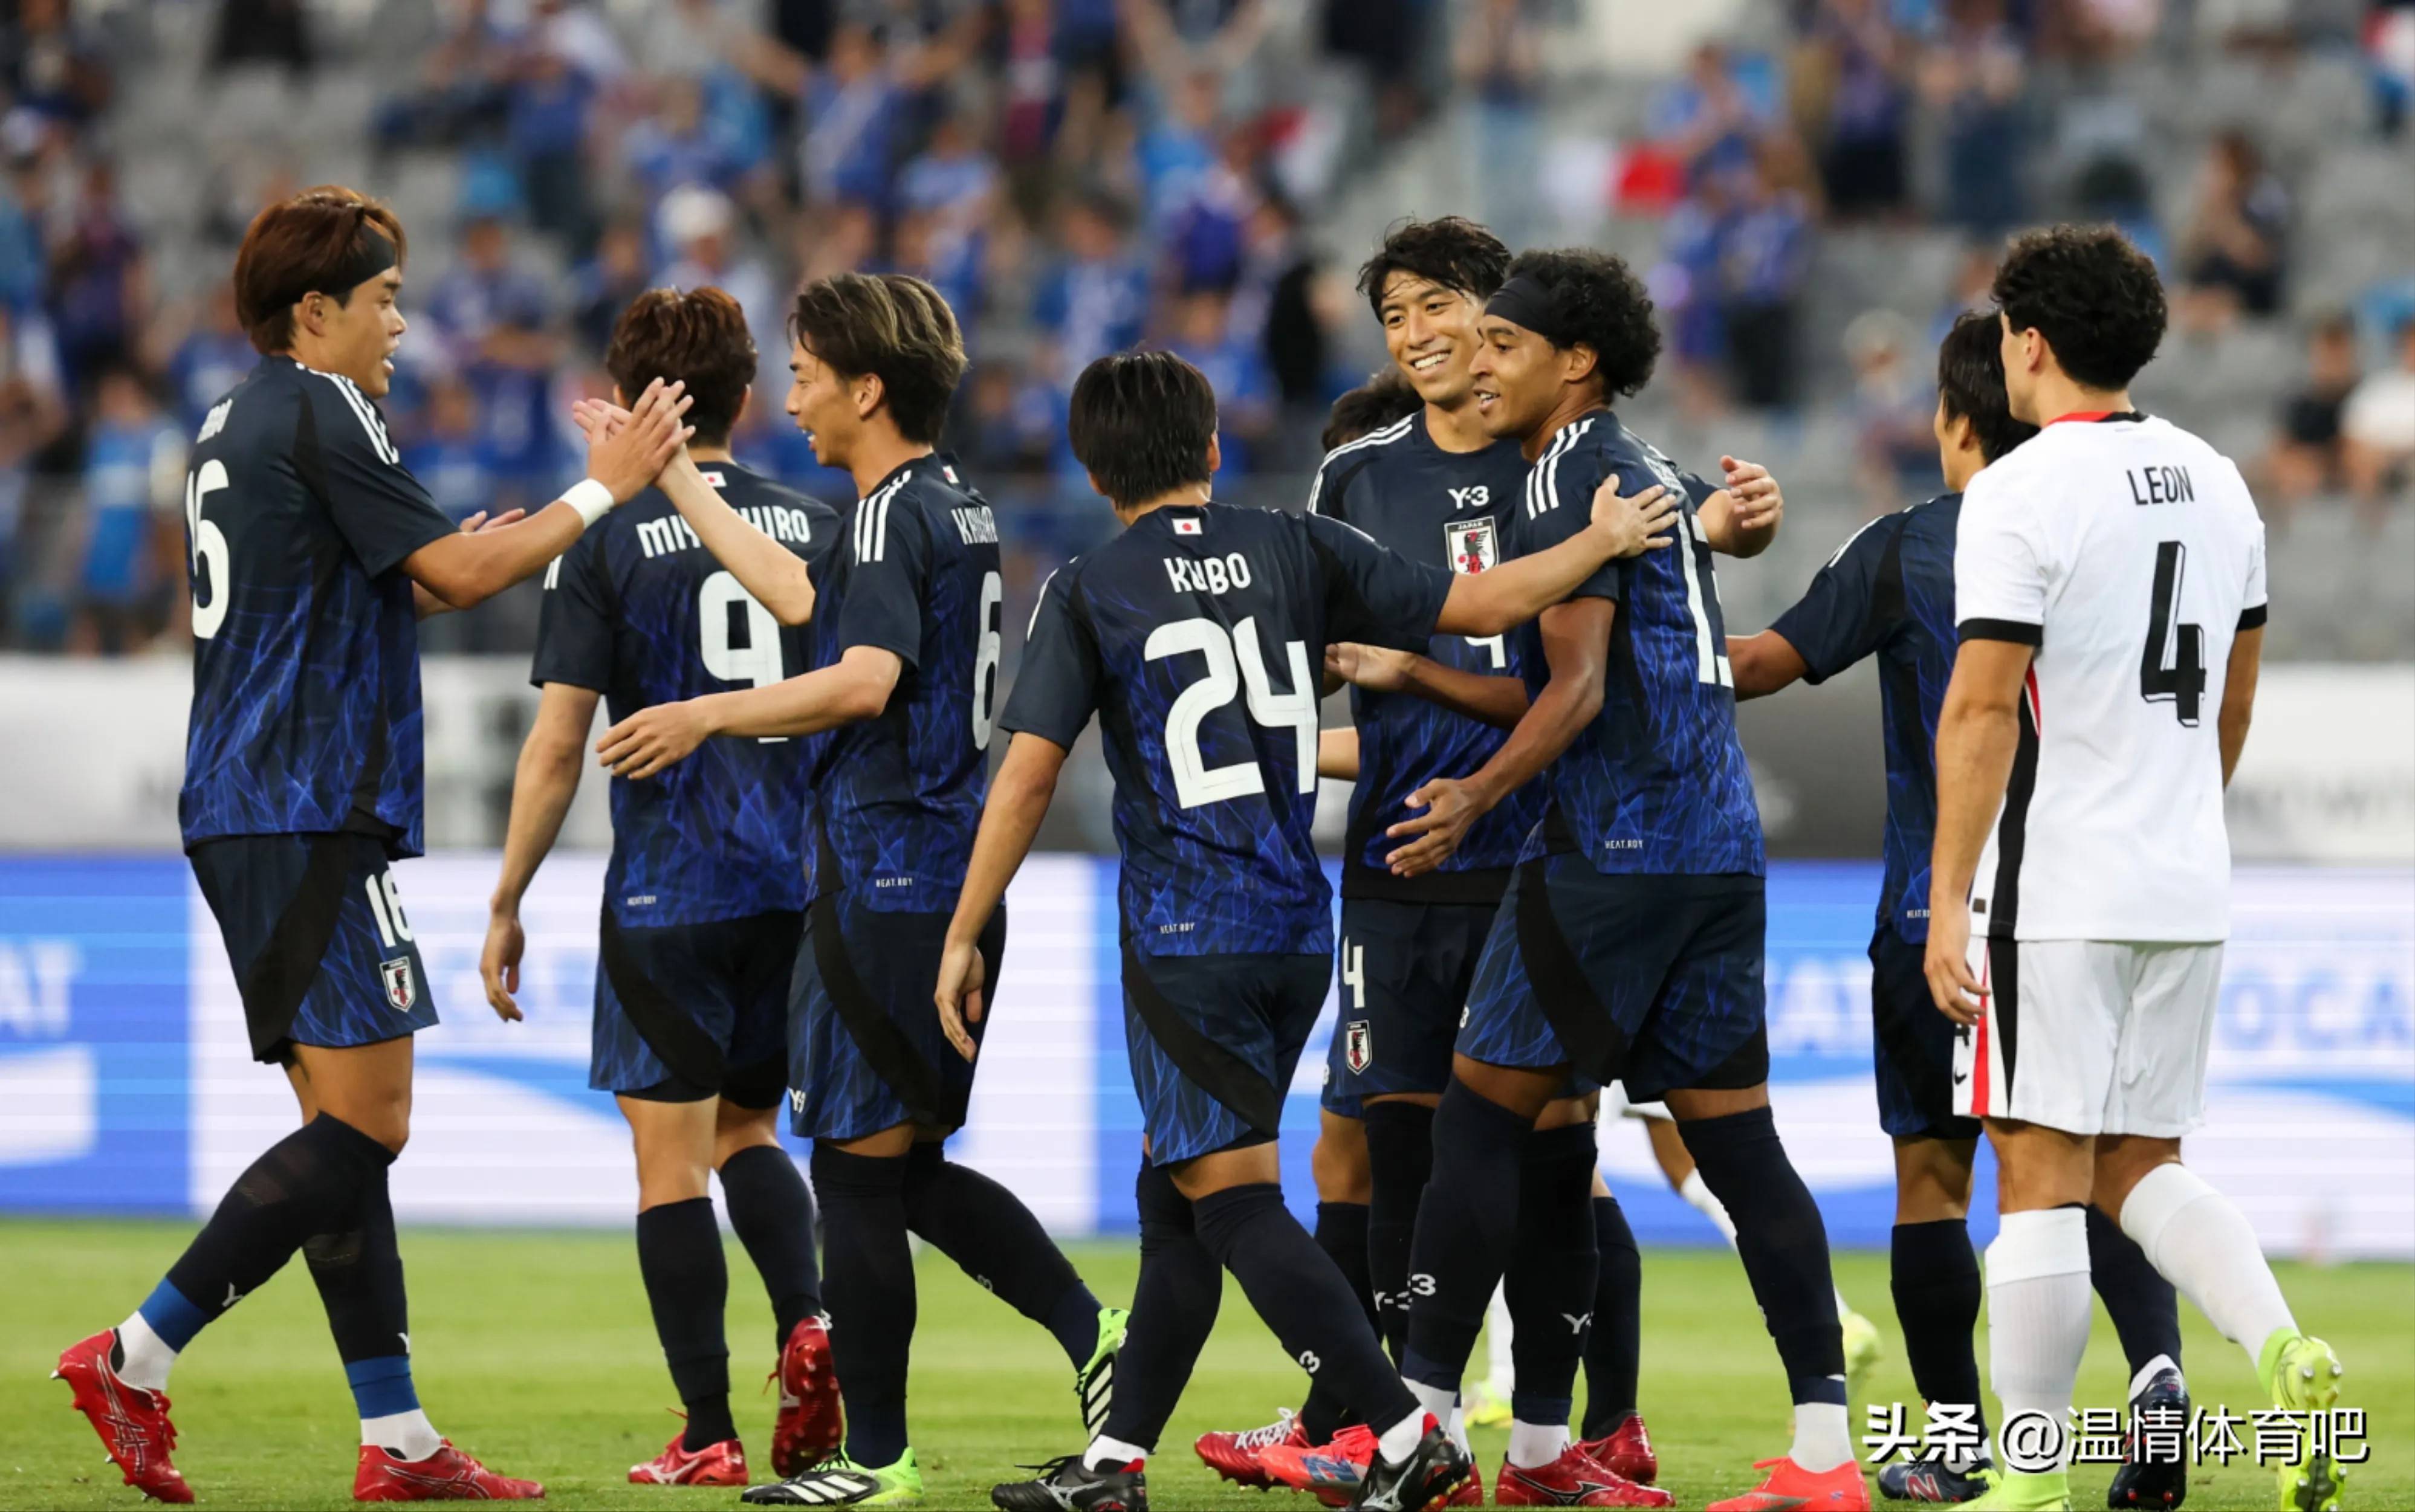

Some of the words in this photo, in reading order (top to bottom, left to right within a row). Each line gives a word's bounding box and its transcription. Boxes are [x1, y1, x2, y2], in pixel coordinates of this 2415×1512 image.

[1447, 485, 1490, 509] Y-3
[2126, 465, 2195, 506] LEON
[635, 505, 811, 559] MIYHIRO
[1163, 552, 1252, 595] KUBO
[698, 570, 789, 745] 9
[2139, 540, 2206, 728] 4
[1144, 615, 1318, 809] 24
[1343, 935, 1365, 1004] 4
